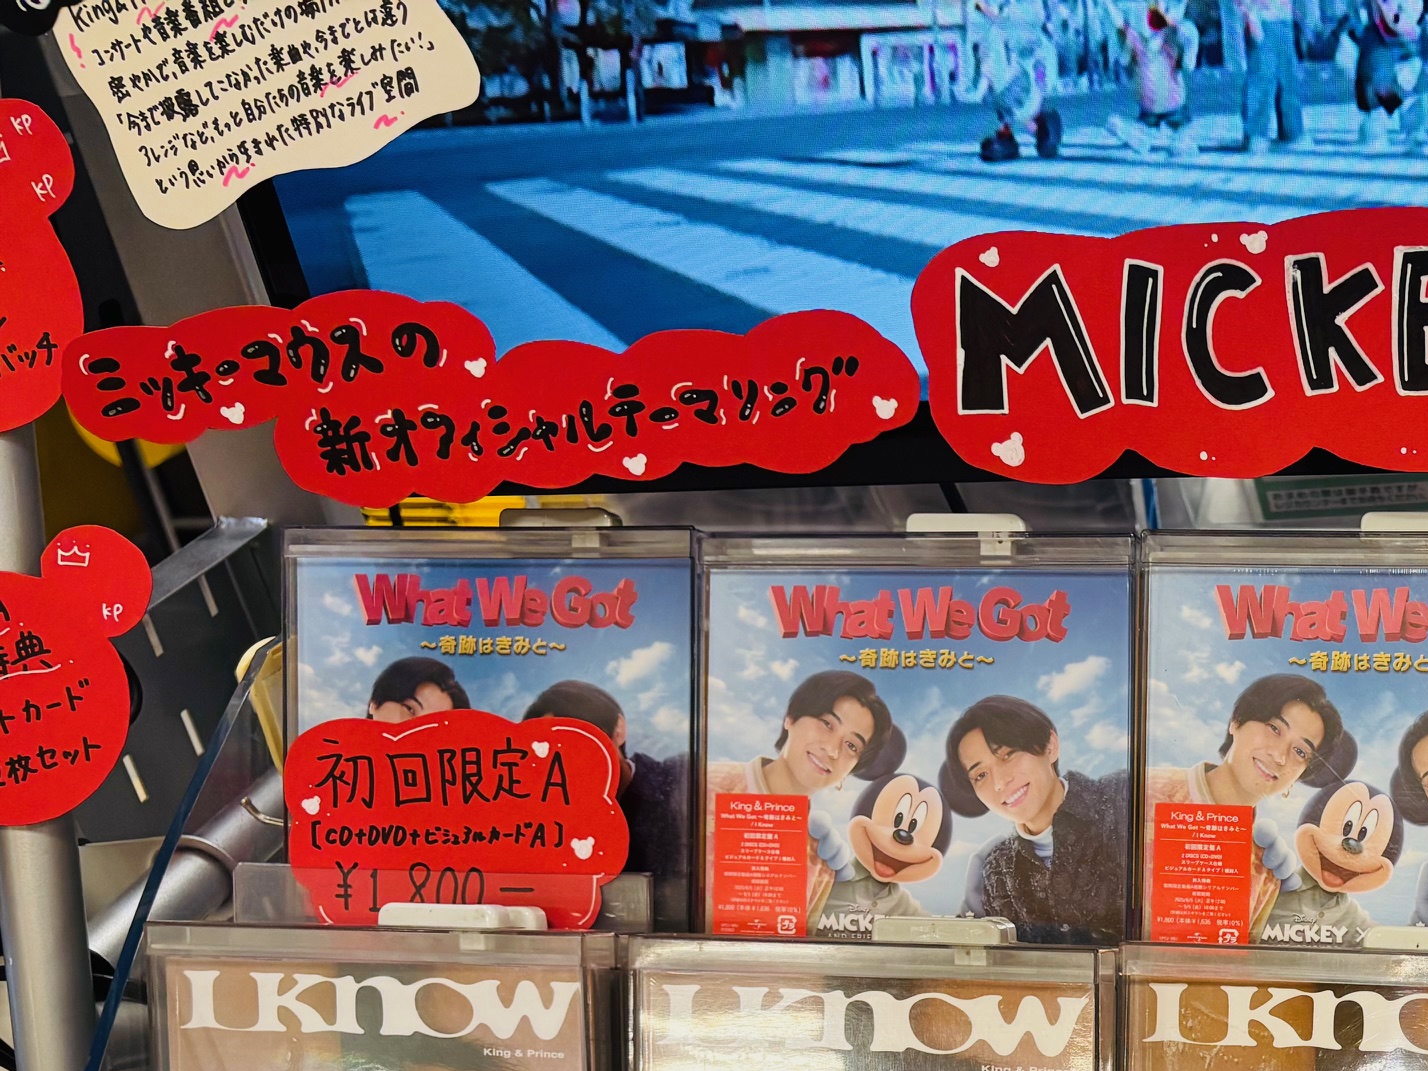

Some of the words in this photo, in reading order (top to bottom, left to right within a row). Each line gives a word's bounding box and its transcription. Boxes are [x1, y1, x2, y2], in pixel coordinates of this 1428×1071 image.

[88, 321, 442, 417] ミッキーマウスの
[318, 356, 860, 475] 新オフィシャルテーマソング
[353, 573, 473, 627] What
[475, 575, 548, 627] We
[551, 576, 639, 629] Got
[768, 585, 896, 640] What
[898, 586, 976, 641] We
[979, 587, 1071, 643] Got
[1214, 584, 1348, 642] What
[0, 736, 102, 787] 枚セット
[730, 801, 752, 813] King
[764, 802, 795, 812] Prince
[1170, 811, 1194, 823] King
[1206, 812, 1239, 823] Prince
[1262, 923, 1349, 943] MICKEY
[483, 1047, 511, 1060] King
[527, 1049, 565, 1060] Prince
